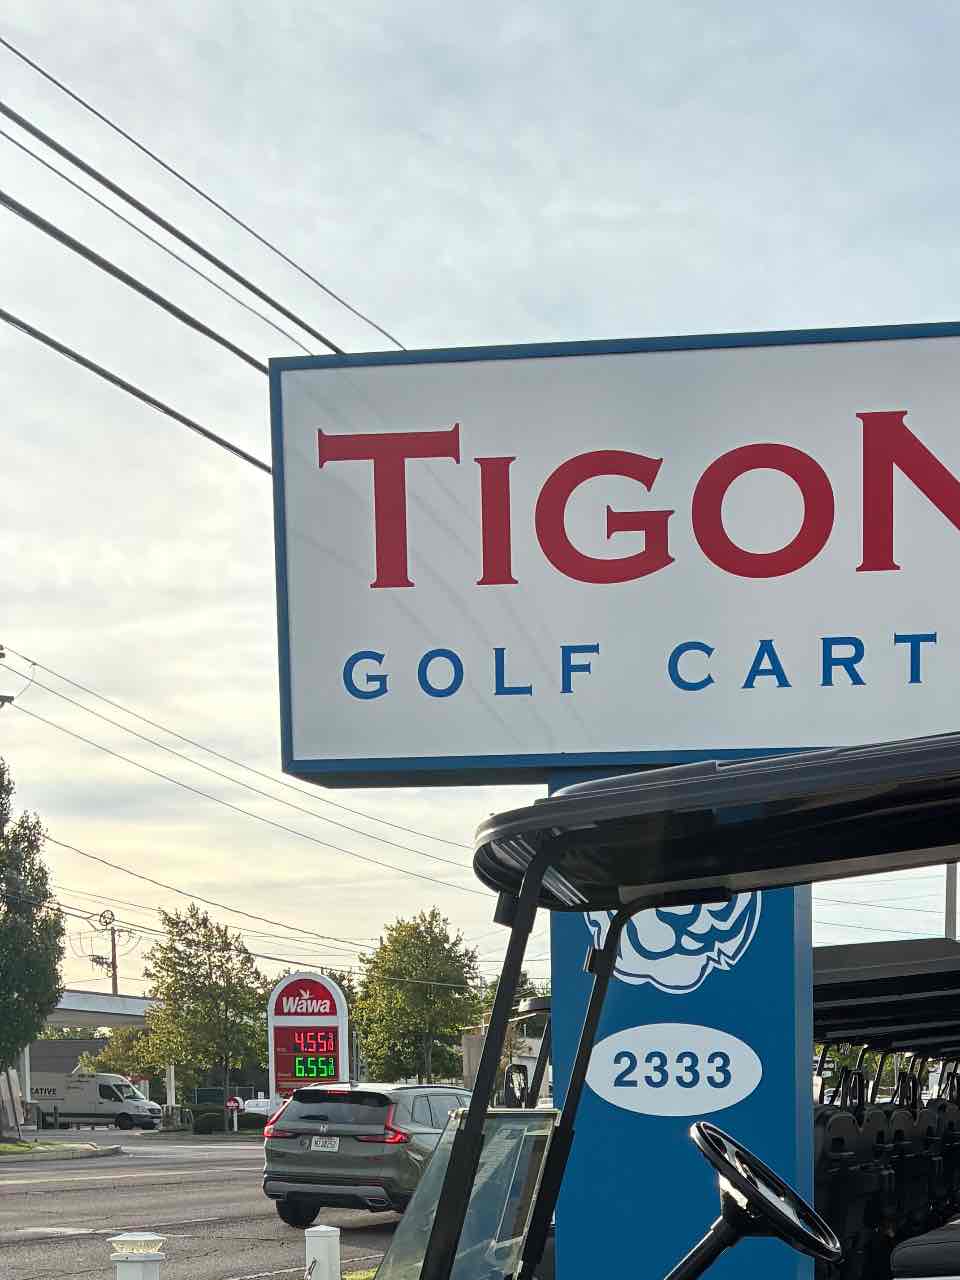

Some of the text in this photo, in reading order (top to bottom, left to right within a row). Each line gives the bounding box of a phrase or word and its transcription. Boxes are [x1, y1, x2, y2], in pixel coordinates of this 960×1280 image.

[343, 643, 600, 700] GOLF
[282, 996, 331, 1014] Wawa
[613, 1051, 732, 1089] 2333
